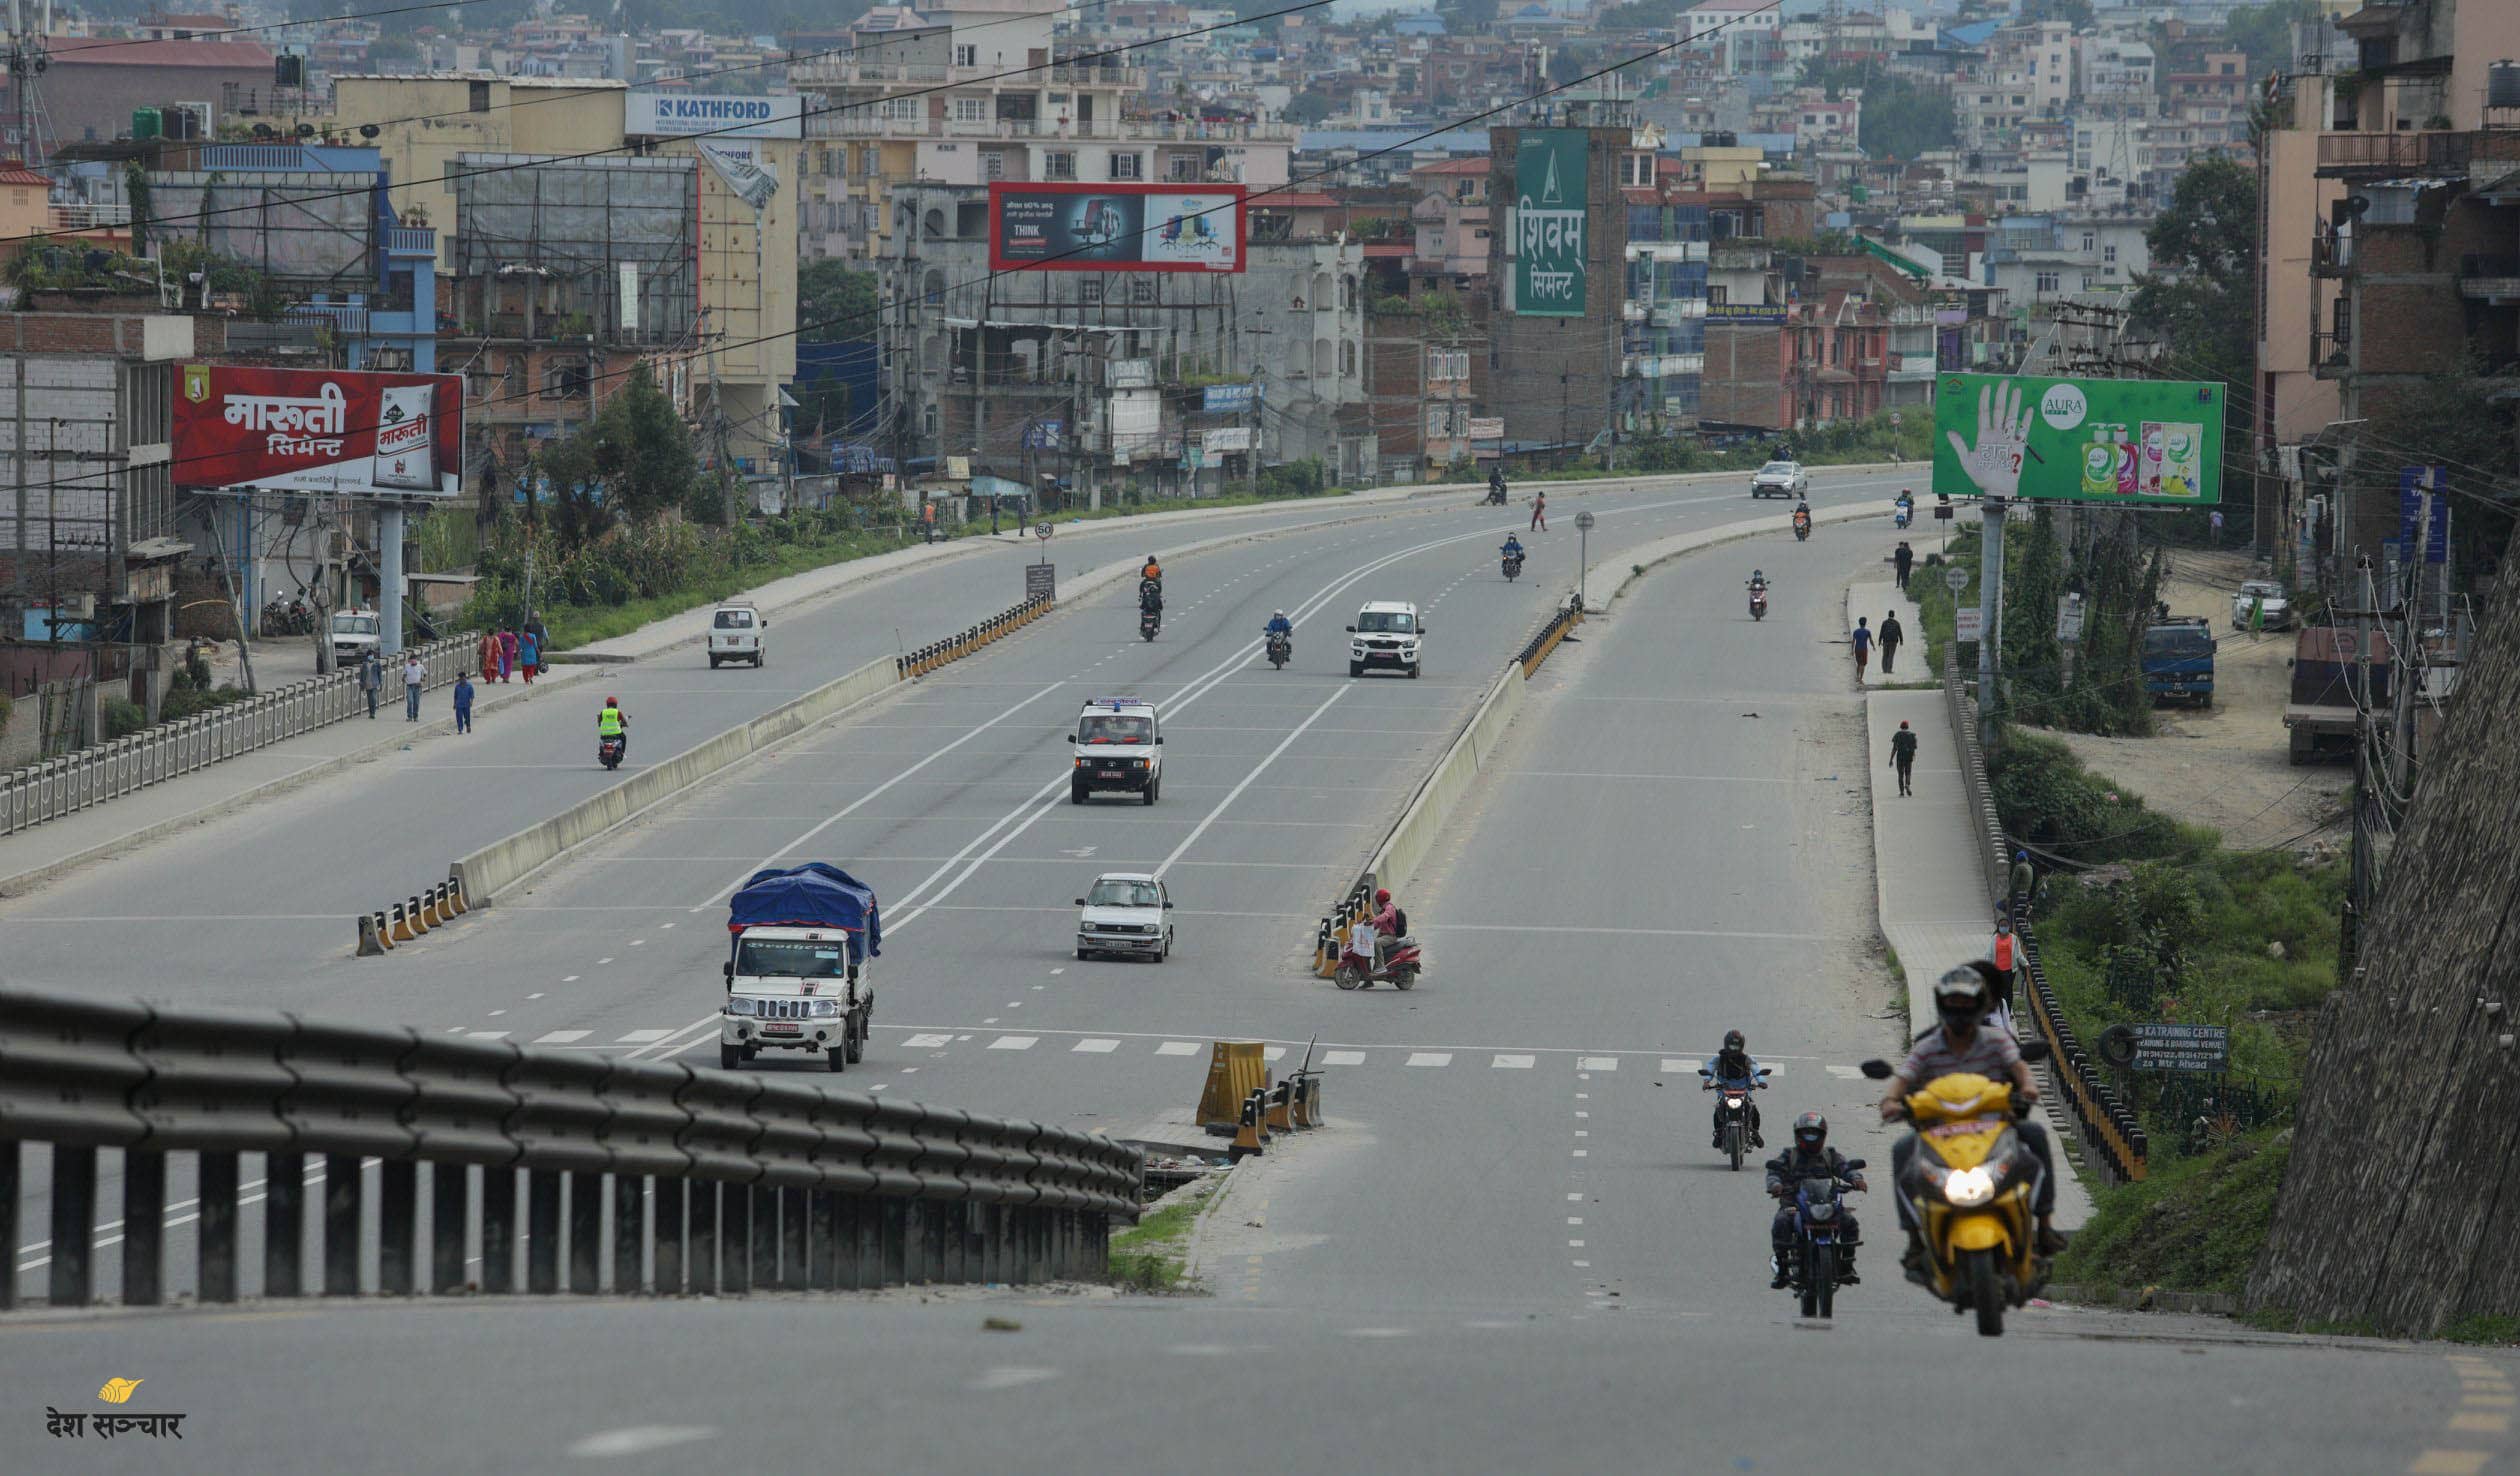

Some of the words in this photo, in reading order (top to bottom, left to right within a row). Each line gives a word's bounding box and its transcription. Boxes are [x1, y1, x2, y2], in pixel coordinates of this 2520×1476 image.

[677, 100, 771, 119] KATHFORD
[1014, 224, 1039, 236] THINK
[1530, 262, 1574, 300] सिमेन्ट
[2045, 399, 2082, 415] AURA
[266, 433, 344, 457] सिमेन्ट
[1038, 525, 1051, 535] 50
[2193, 1028, 2225, 1039] CENTRE
[2178, 1060, 2208, 1070] Ahead
